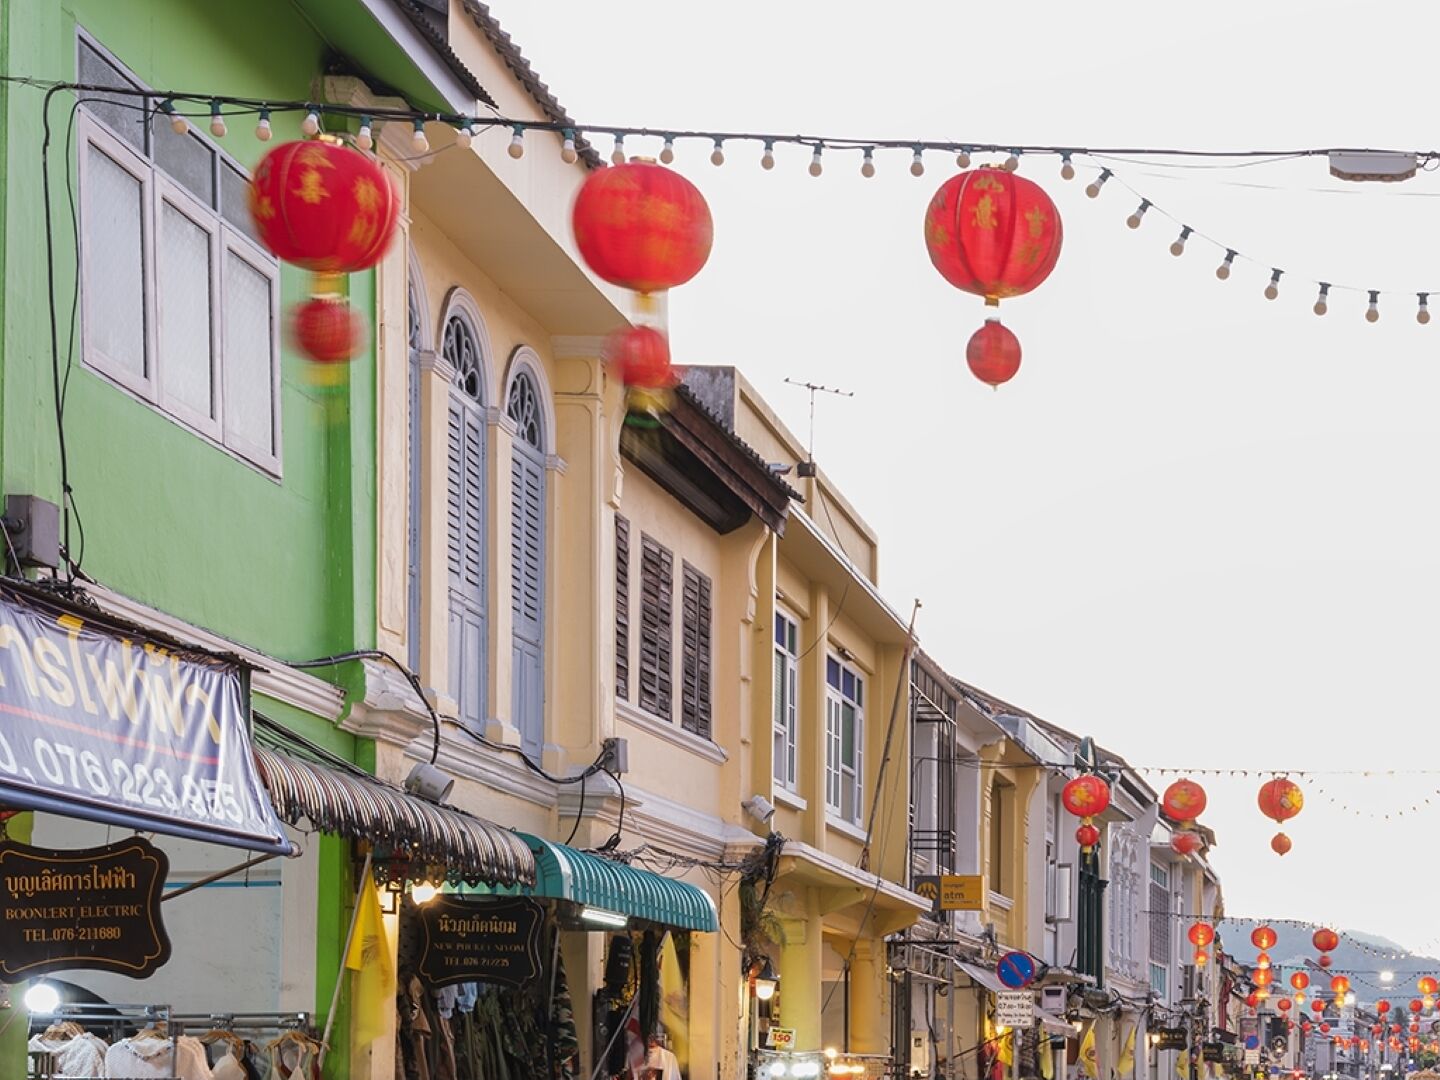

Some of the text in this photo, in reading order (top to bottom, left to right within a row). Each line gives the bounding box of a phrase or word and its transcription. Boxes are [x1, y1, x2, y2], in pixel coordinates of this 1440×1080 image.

[6, 865, 136, 898] บุญเลิศการไฟฟ้า
[6, 904, 143, 920] BOONLERT ELECTRIC
